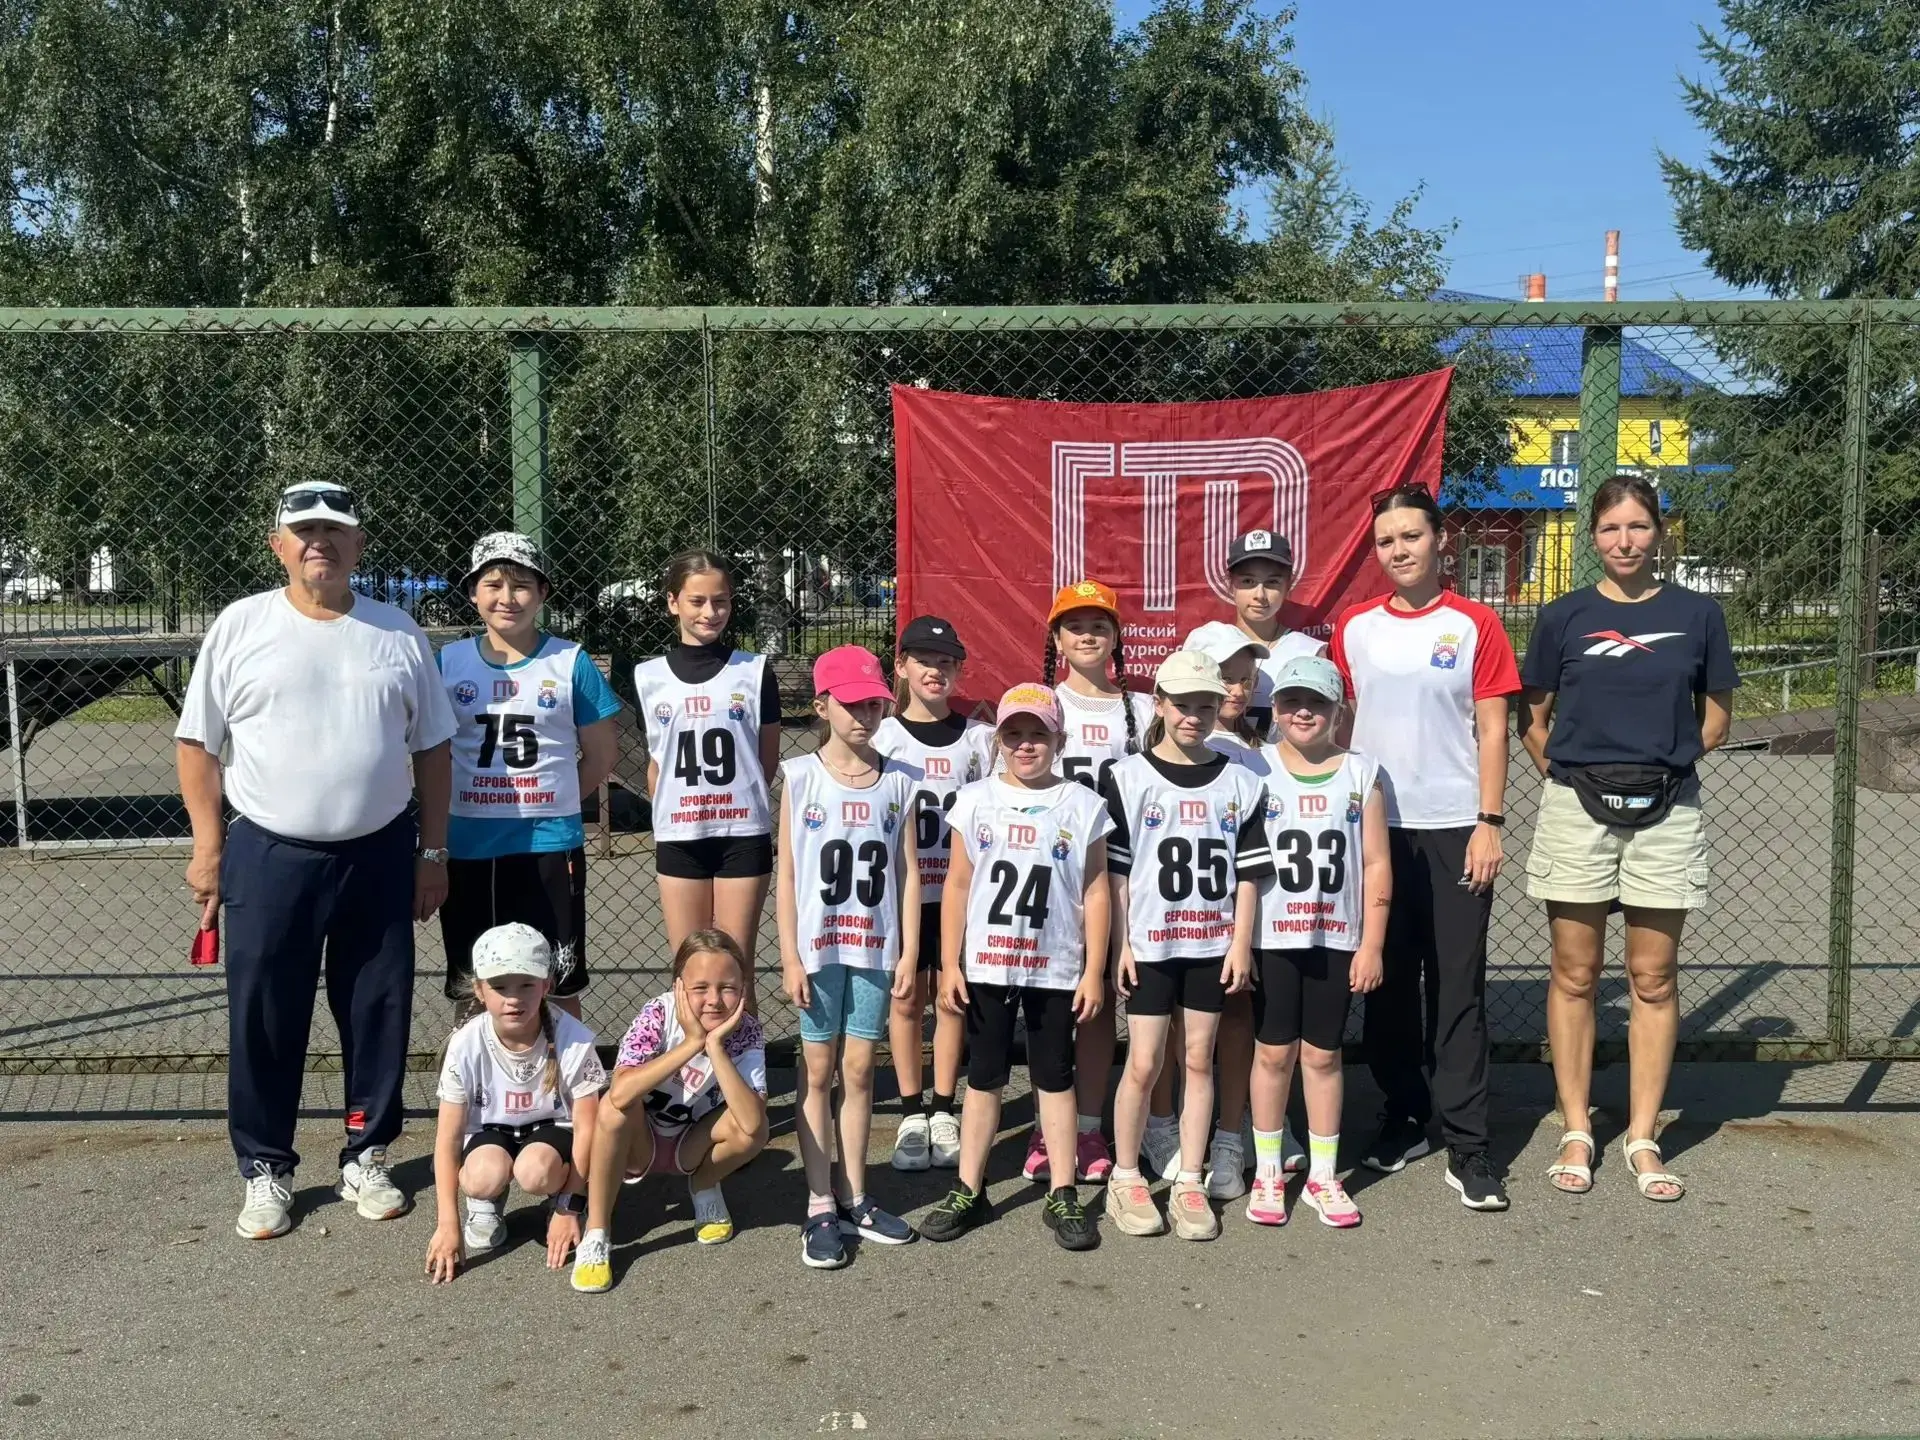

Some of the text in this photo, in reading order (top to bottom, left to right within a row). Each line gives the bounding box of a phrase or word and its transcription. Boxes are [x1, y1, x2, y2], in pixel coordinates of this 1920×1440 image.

[1052, 437, 1309, 612] ГТО
[1121, 622, 1177, 638] ийский
[493, 680, 520, 697] ГТО
[685, 696, 711, 713] ГТО
[1082, 724, 1108, 740] ГТО
[475, 713, 539, 769] 75
[674, 727, 737, 787] 49
[925, 757, 951, 774] ГТО
[472, 775, 539, 789] СЕРОВСКИЙ
[460, 789, 556, 805] ГОРОДСКОЙ ОКРУГ
[680, 792, 733, 807] СЕРОВСКИЙ
[1298, 794, 1327, 812] ГТО
[719, 808, 750, 820] ОКРУГ
[842, 801, 870, 820] ГТО
[1179, 800, 1206, 818] ГТО
[1008, 824, 1037, 844] ГТО
[918, 857, 950, 869] ЕРОВС
[1157, 836, 1228, 902] 85
[1277, 829, 1346, 894] 33
[820, 839, 888, 907] 93
[987, 859, 1052, 929] 24
[1164, 908, 1222, 923] СЕРОВСКИЙ
[1148, 925, 1208, 942] ГОРОДСКОЙ
[987, 934, 1039, 951] СЕРОВСКИЙ
[975, 952, 1022, 967] ГОРОДСКОЙ
[505, 1090, 533, 1108] ГТО
